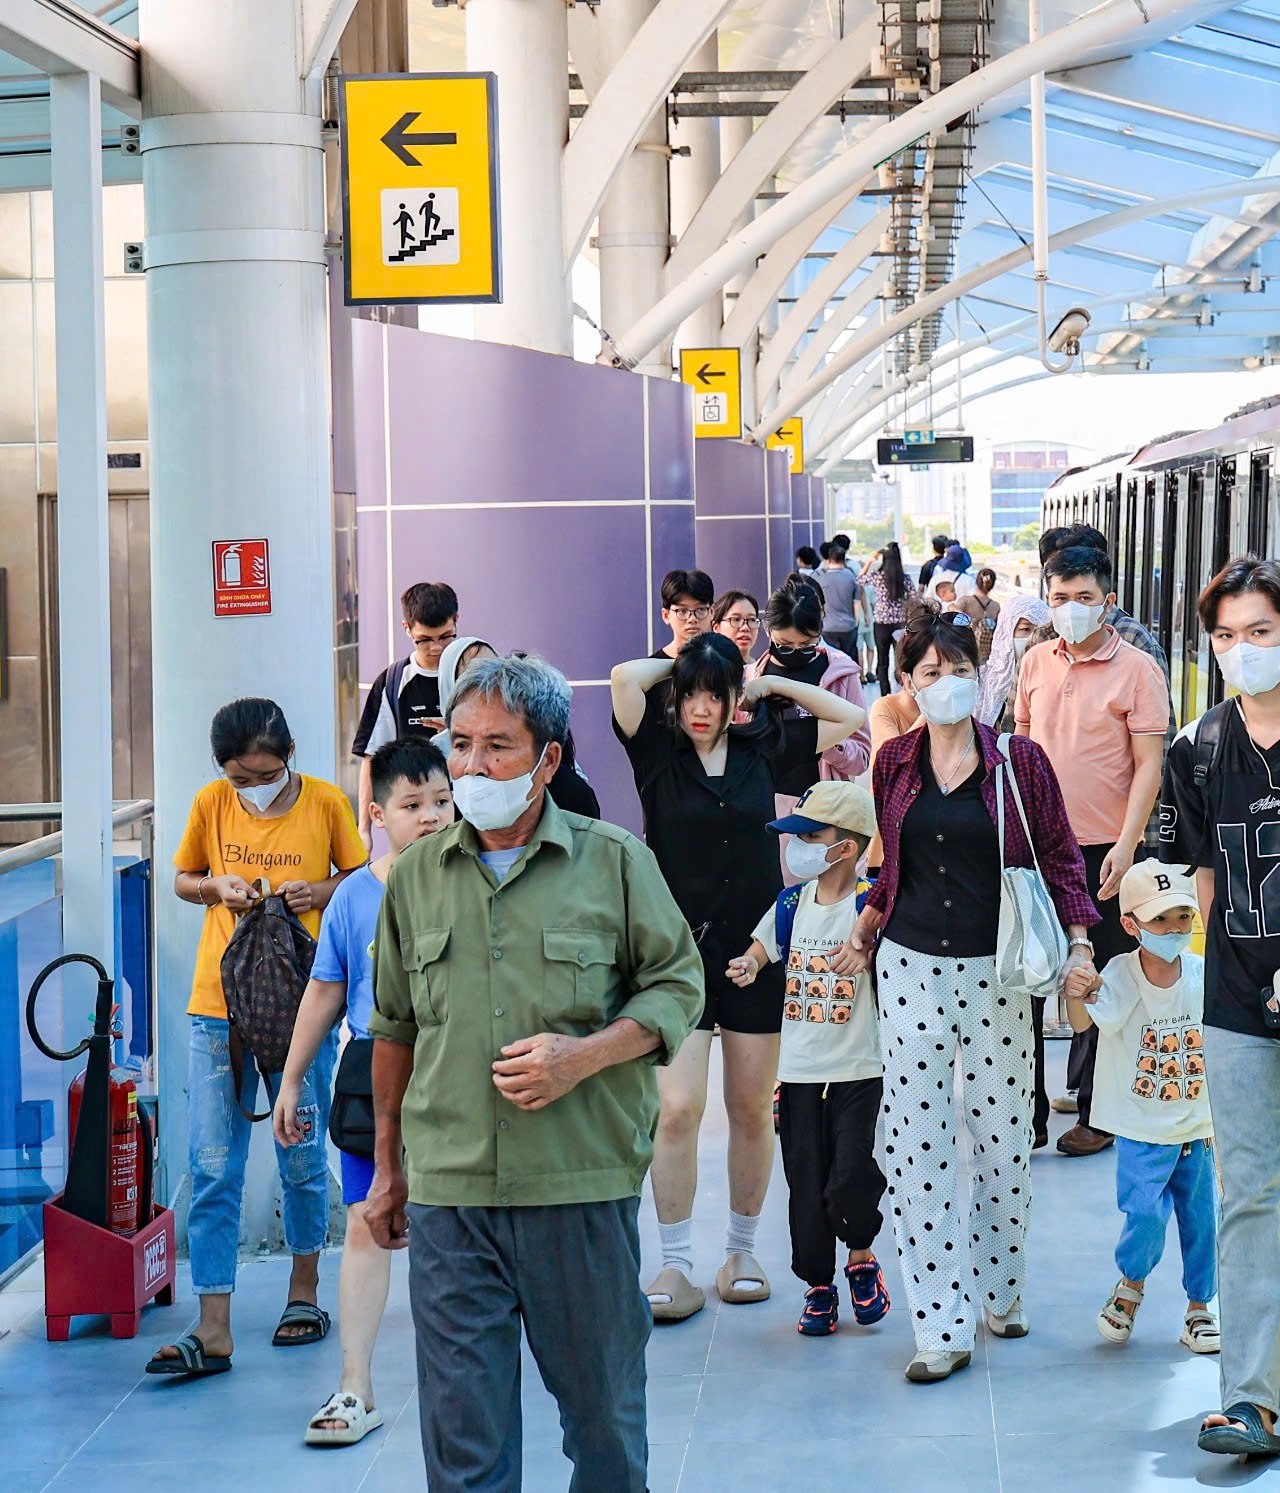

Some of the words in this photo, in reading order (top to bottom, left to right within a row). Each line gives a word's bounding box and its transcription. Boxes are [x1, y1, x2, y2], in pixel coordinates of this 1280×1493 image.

[224, 843, 302, 871] Blengano
[1154, 873, 1171, 891] B
[798, 937, 819, 946] CAPY
[1149, 1018, 1170, 1026] APY
